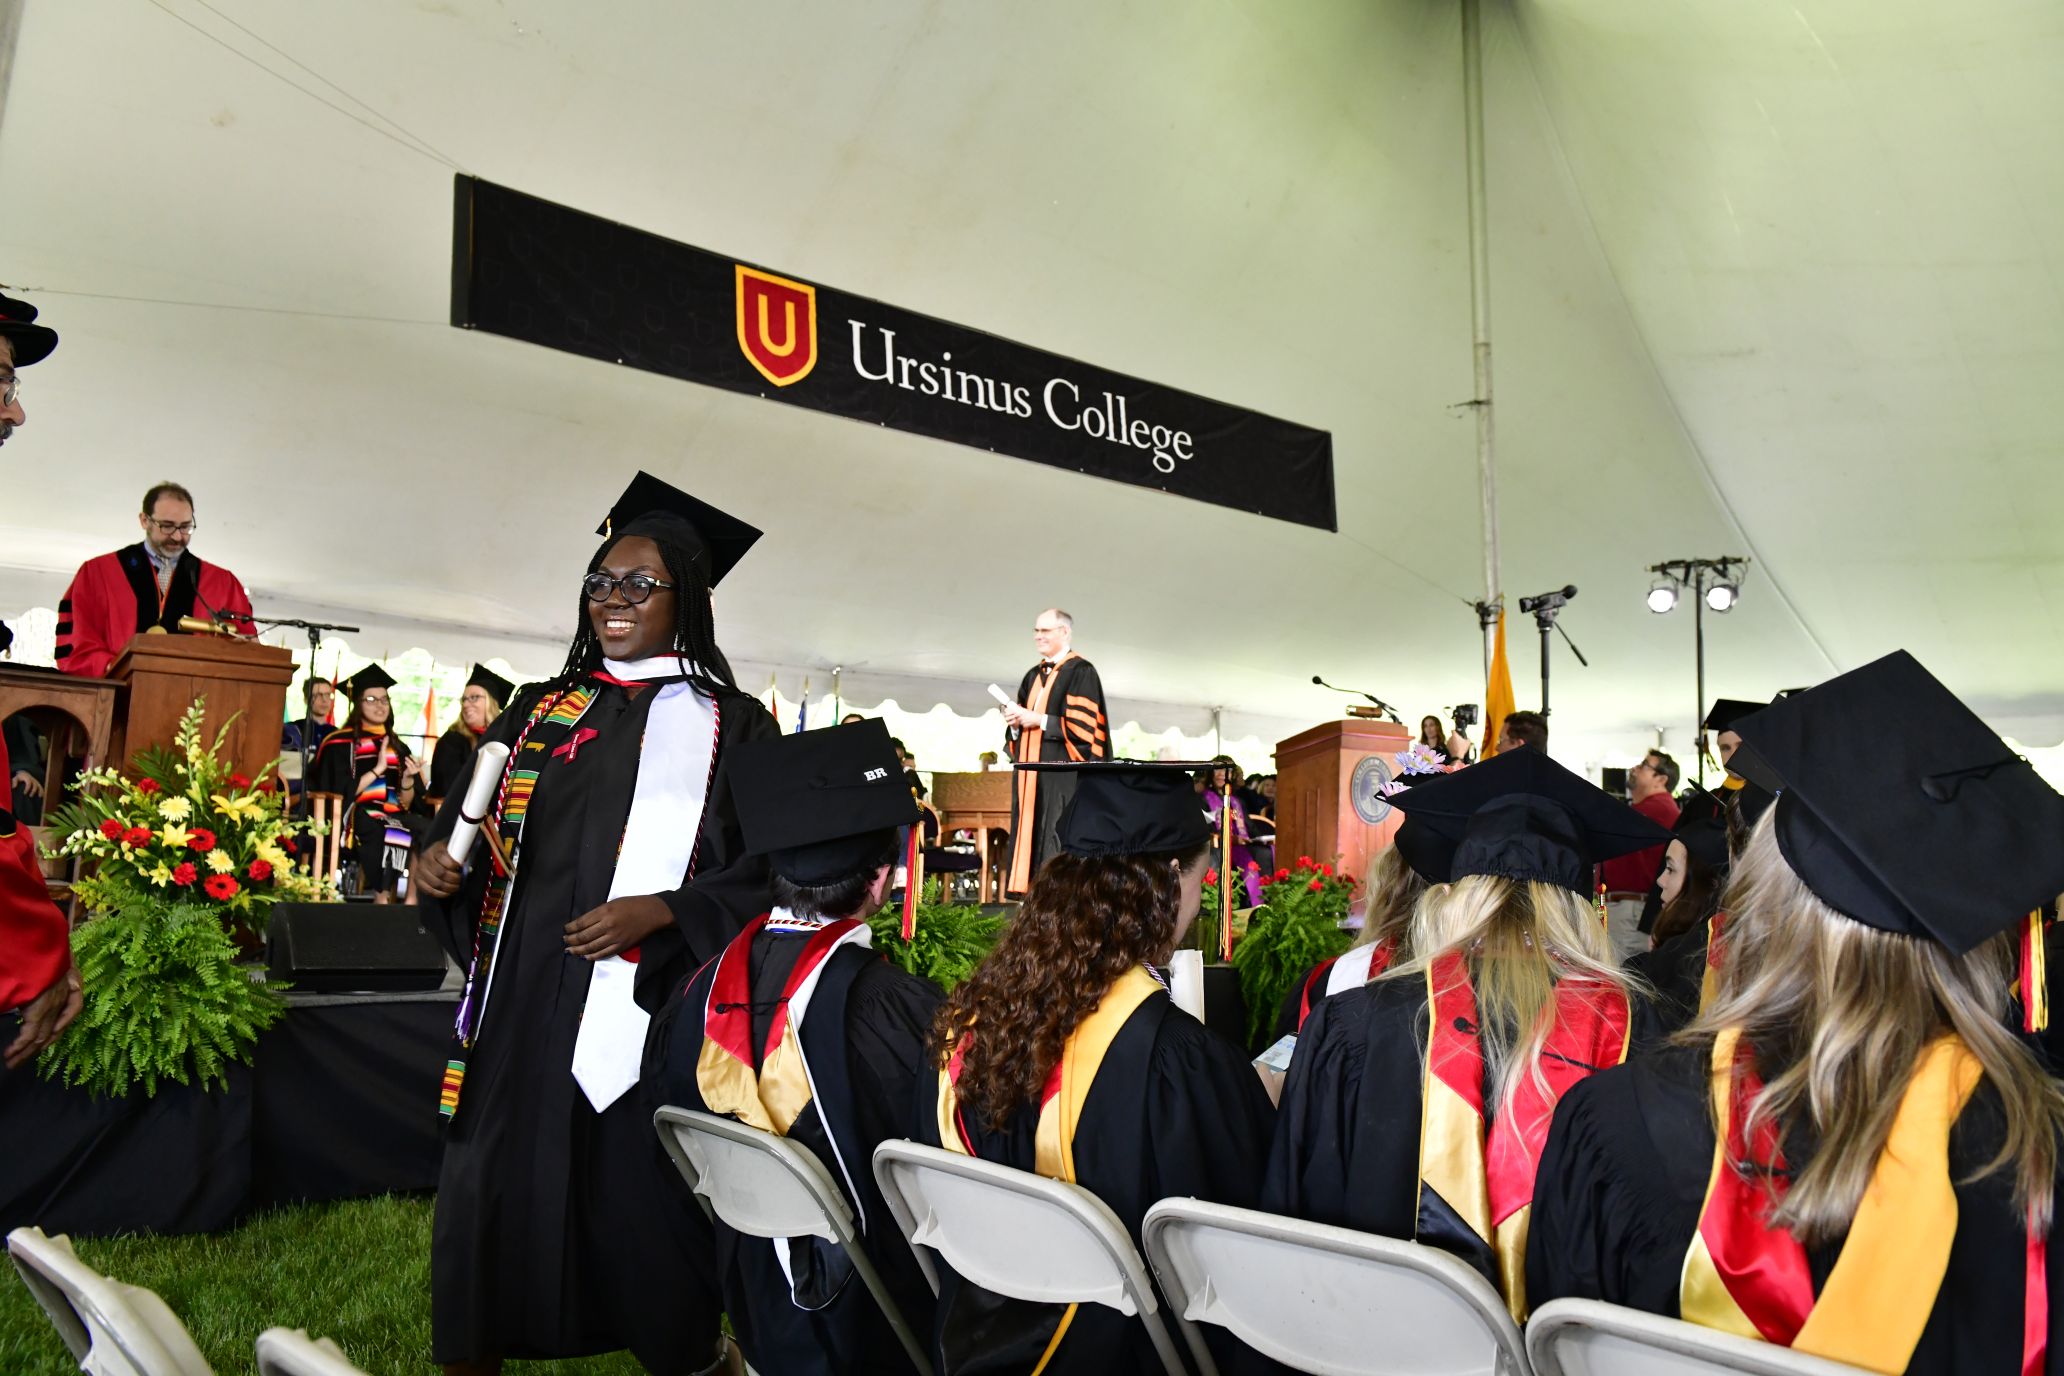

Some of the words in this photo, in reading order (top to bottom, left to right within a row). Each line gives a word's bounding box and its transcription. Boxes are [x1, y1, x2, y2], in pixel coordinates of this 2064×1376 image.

[758, 293, 796, 357] U
[848, 319, 1032, 418] Ursinus
[1043, 378, 1195, 473] College
[863, 767, 888, 781] BR
